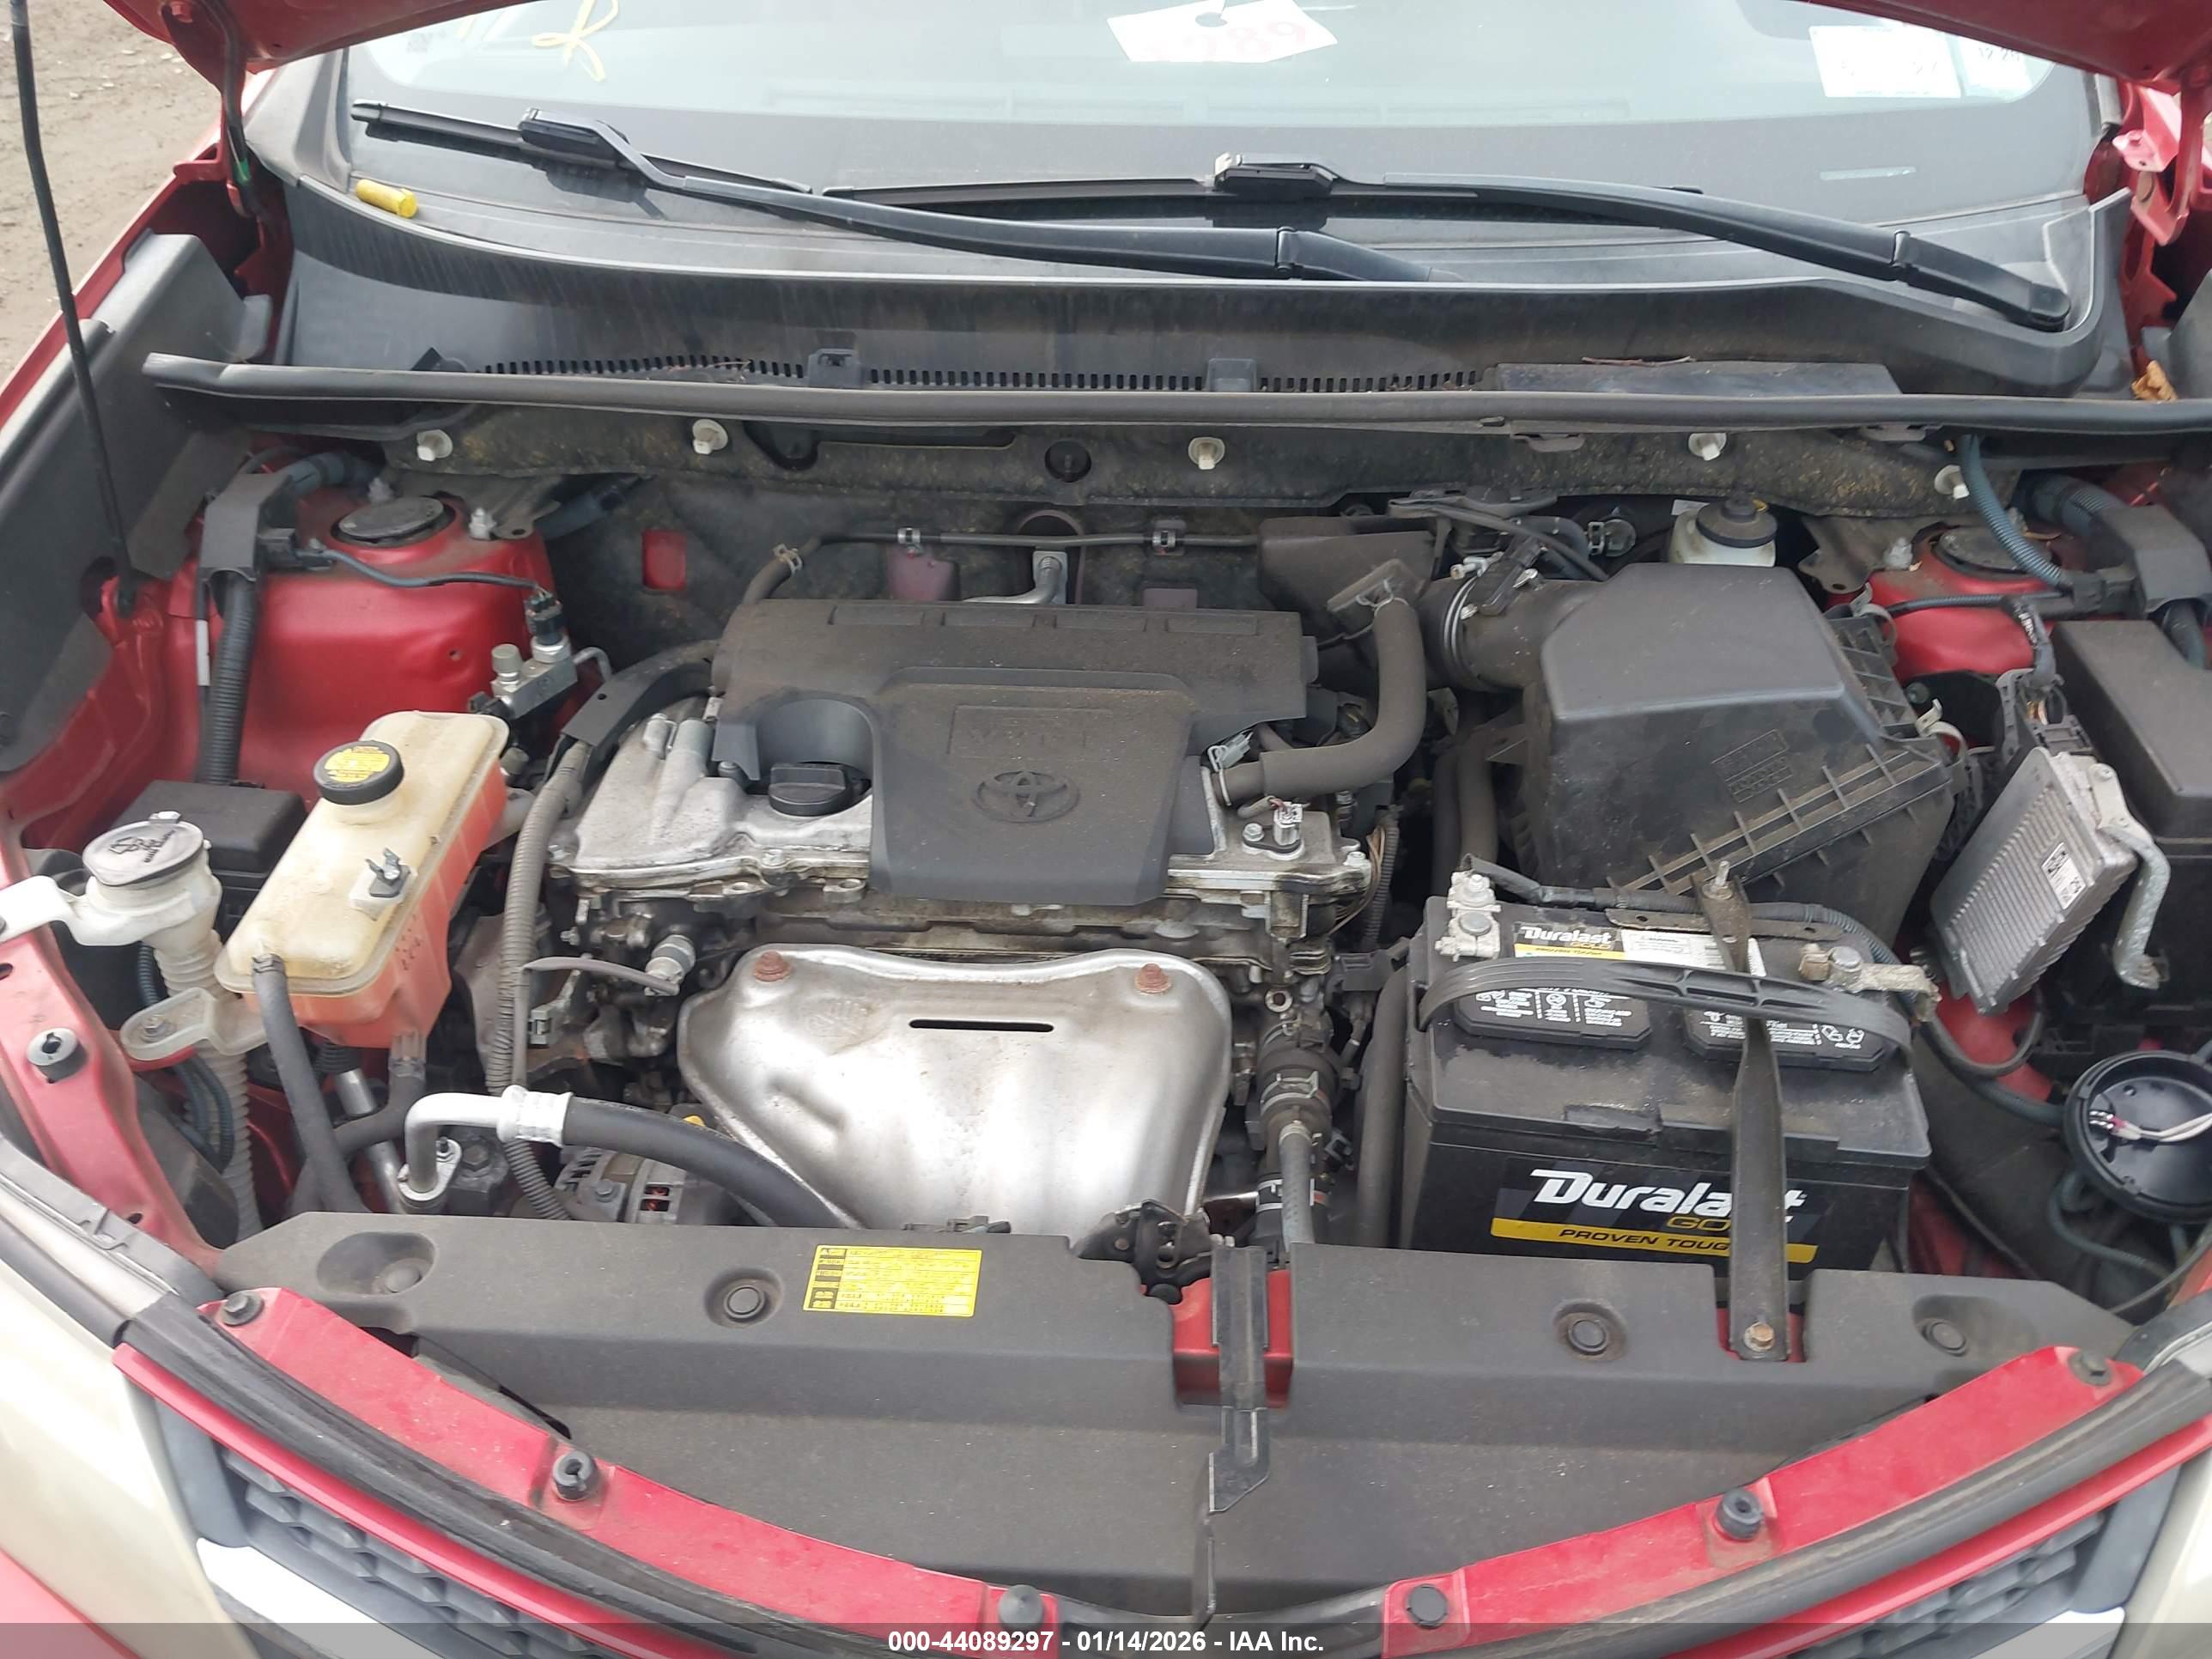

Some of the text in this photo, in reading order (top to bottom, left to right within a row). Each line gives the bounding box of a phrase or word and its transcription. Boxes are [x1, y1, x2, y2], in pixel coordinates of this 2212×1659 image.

[1520, 926, 1613, 945] Duralast
[1530, 1169, 1806, 1224] Duralat
[1667, 1215, 1731, 1232] GO
[1559, 1229, 1731, 1252] PROVEN TOUG
